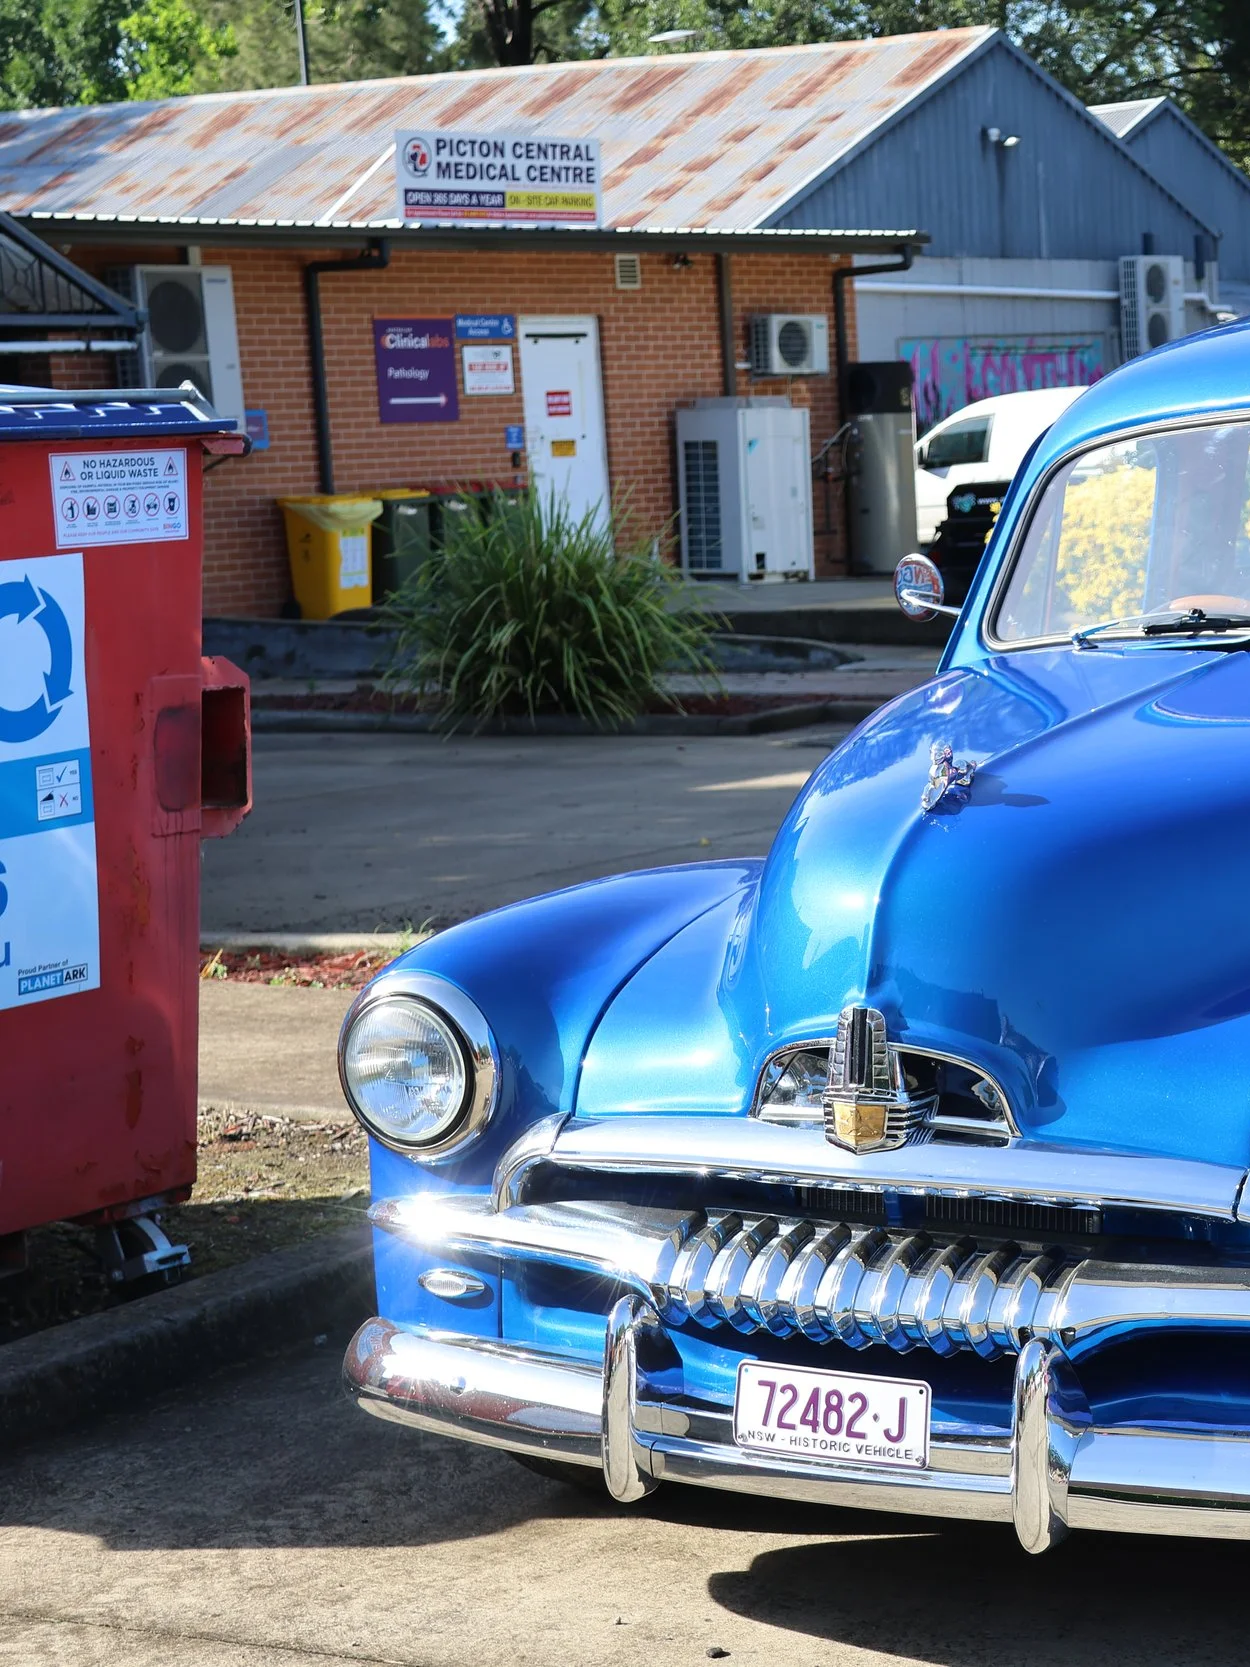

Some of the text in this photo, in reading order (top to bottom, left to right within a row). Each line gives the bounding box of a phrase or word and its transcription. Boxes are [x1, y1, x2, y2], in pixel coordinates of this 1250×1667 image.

[436, 138, 595, 161] PICTON CENTRAL
[436, 162, 596, 183] MEDICAL CENTRE
[406, 192, 504, 206] OPEN 365 DAYS A YEAR
[387, 367, 430, 381] Pathology
[83, 457, 155, 469] NO HAZARDOUS
[80, 468, 159, 480] OR LIQUID WASTE
[17, 958, 69, 976] Proud Partner of
[20, 967, 86, 992] PLANET ARK
[747, 1430, 776, 1442] NSW
[789, 1436, 850, 1452] HISTORIC
[856, 1444, 913, 1460] VEHICLE
